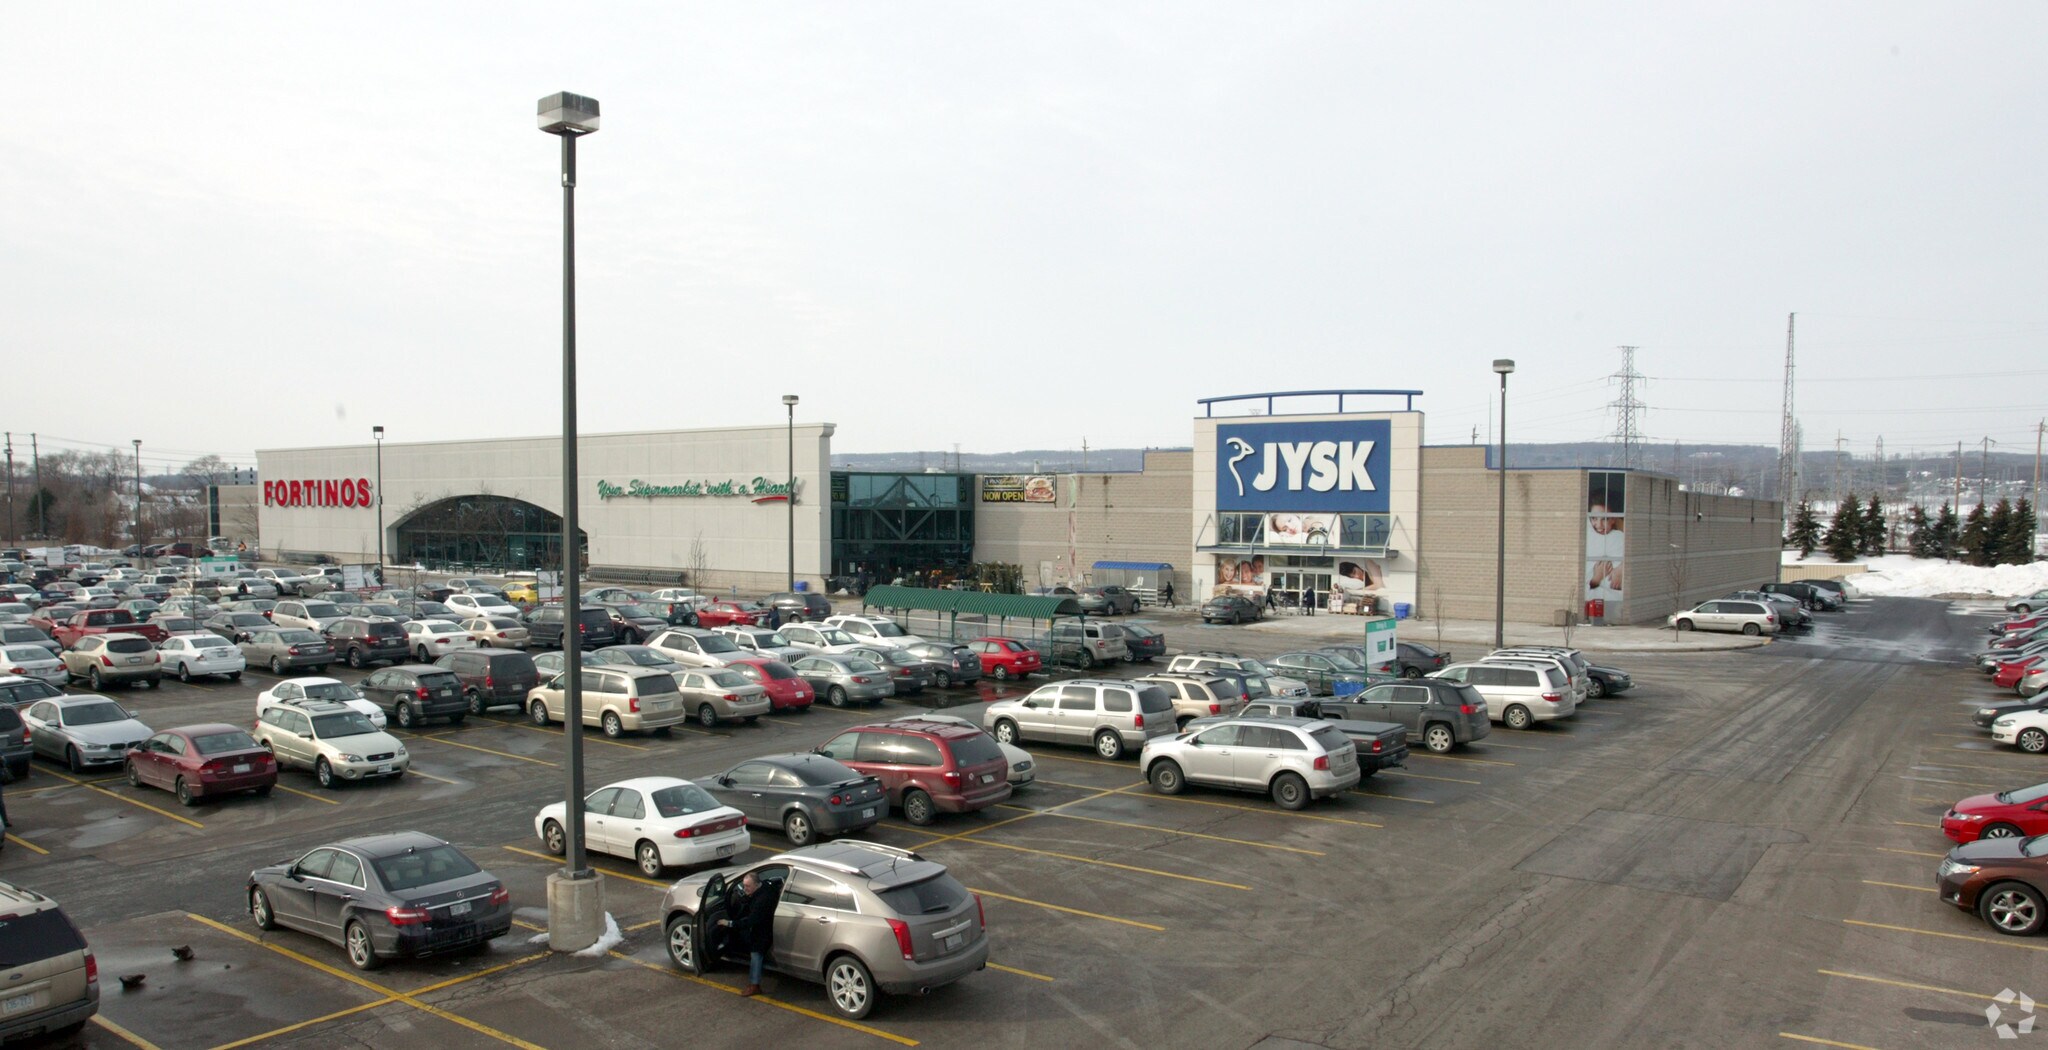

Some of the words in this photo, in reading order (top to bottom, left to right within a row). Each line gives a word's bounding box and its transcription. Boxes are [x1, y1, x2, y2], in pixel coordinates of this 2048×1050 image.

[1252, 441, 1376, 492] JYSK
[263, 478, 371, 508] FORTINOS
[598, 479, 622, 500] Your
[627, 479, 700, 498] Supermarket
[738, 484, 747, 495] a
[983, 491, 1001, 501] NOW
[1002, 491, 1024, 501] OPEN
